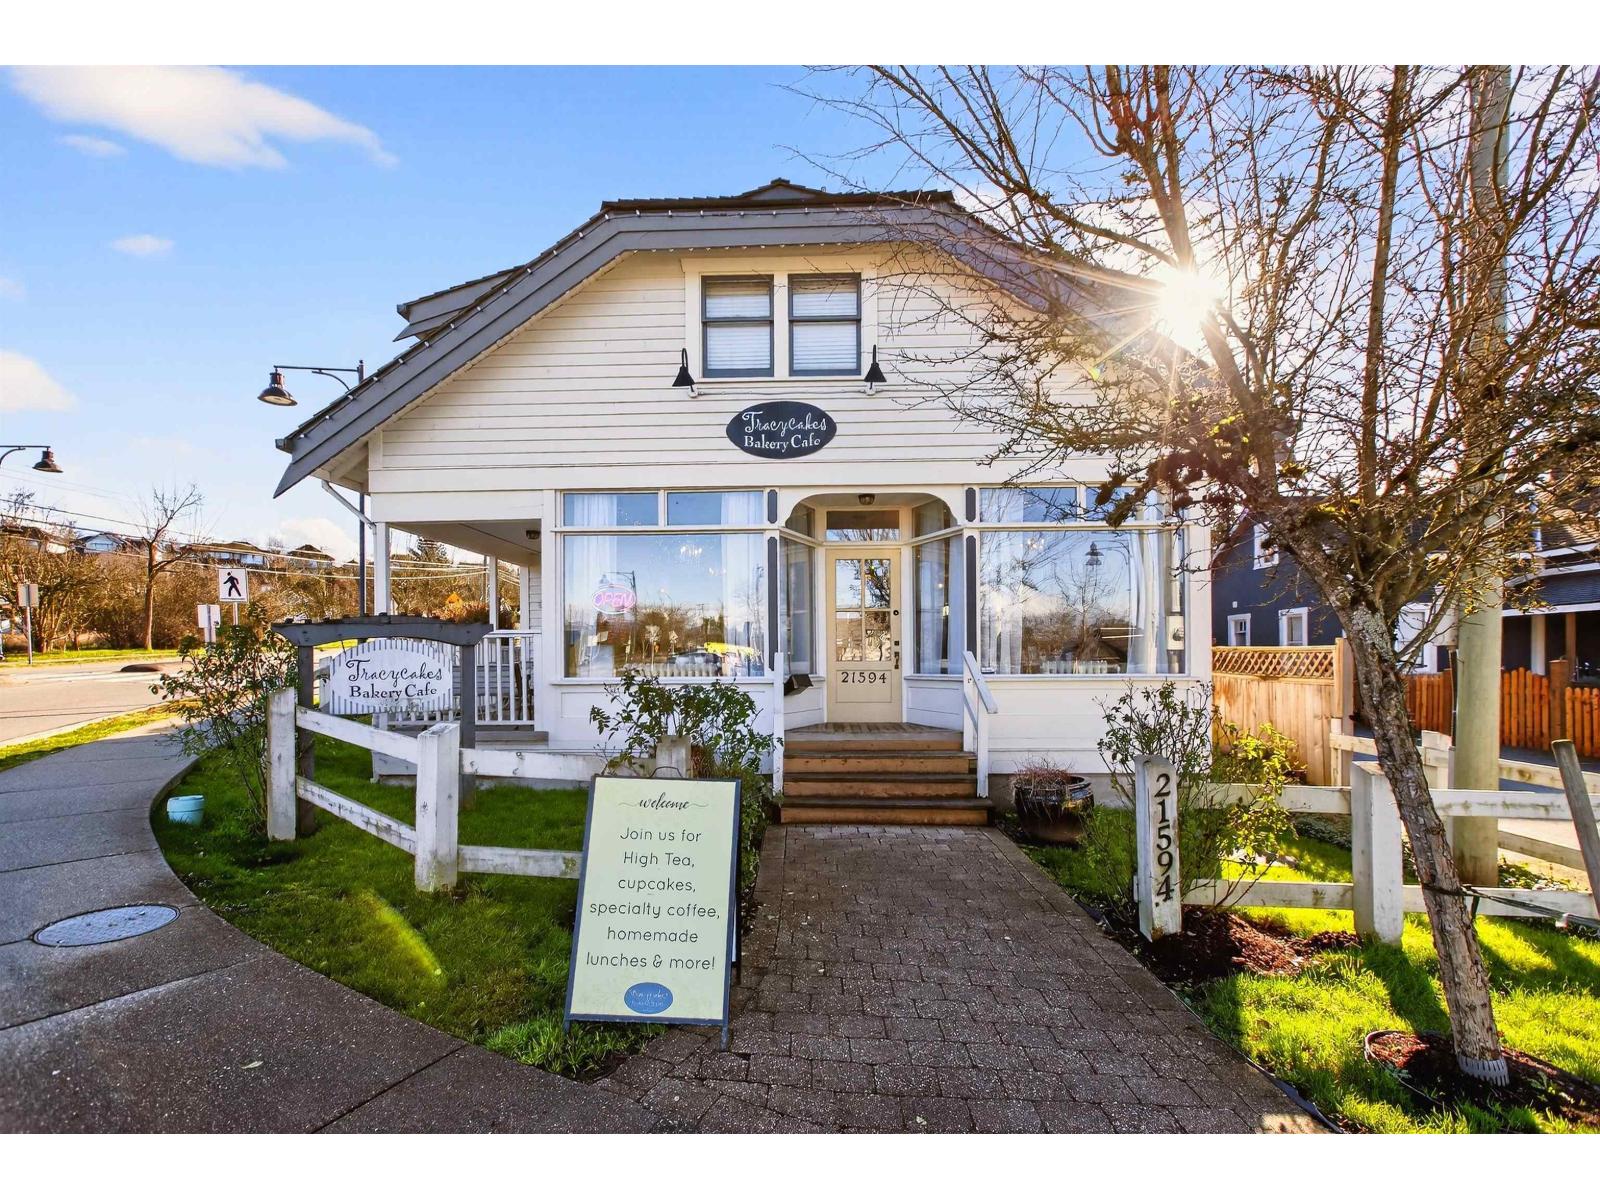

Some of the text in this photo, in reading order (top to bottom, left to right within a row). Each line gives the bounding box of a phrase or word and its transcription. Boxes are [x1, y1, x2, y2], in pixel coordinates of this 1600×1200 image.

[741, 411, 827, 437] Tracycakes
[744, 432, 821, 453] Bakery Cafe
[594, 591, 635, 608] OPEN
[345, 659, 443, 687] Tracycakes
[841, 671, 887, 684] 21594
[349, 682, 437, 701] Bakery Cafe
[639, 792, 690, 811] welcome
[620, 827, 702, 843] Join us for
[1154, 773, 1175, 903] 21594
[623, 851, 695, 868] High Tea,
[618, 878, 696, 893] cupcakes,
[590, 902, 720, 919] specialty coffee,
[607, 926, 699, 943] homemade
[586, 952, 715, 970] lunches & more!
